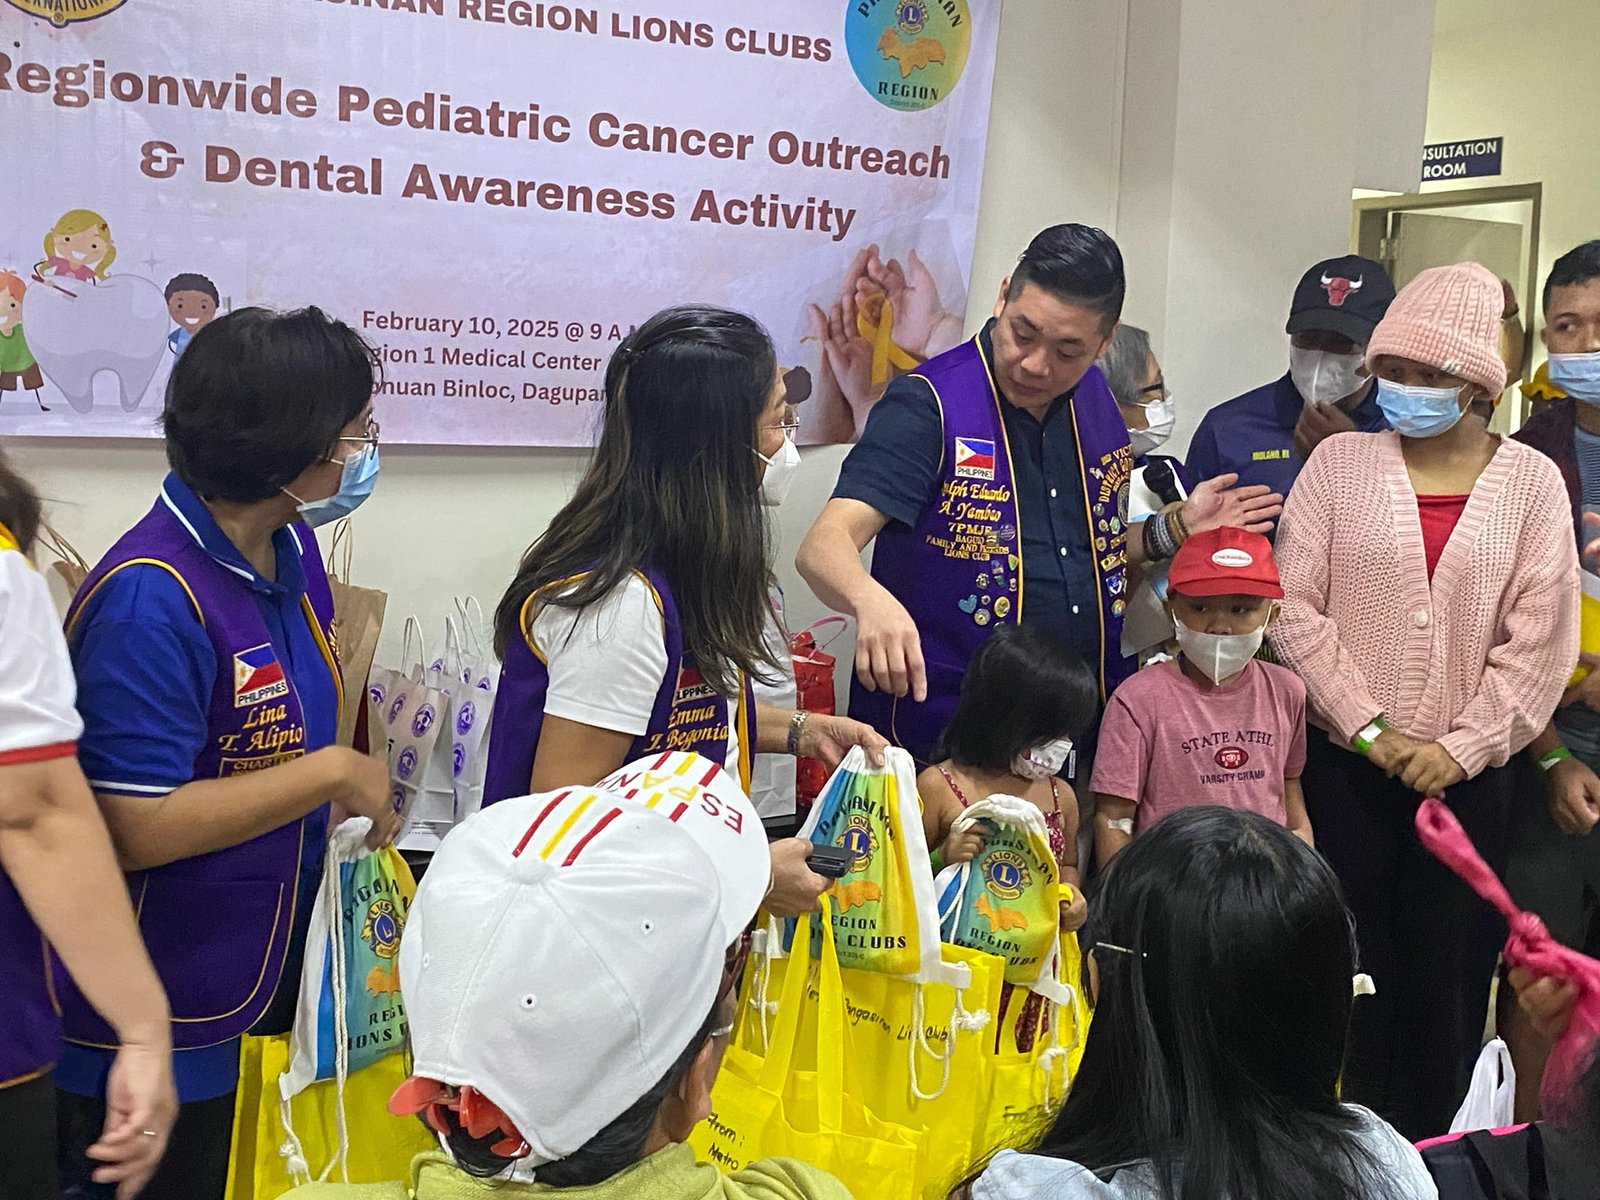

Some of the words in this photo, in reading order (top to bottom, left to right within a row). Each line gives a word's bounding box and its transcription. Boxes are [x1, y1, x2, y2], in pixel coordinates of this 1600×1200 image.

[458, 0, 598, 34] REGION
[611, 12, 714, 49] LIONS
[725, 27, 832, 62] CLUBS
[878, 81, 940, 101] REGION
[338, 85, 571, 144] Pediatric
[588, 112, 754, 161] Cancer
[768, 131, 951, 180] Outreach
[1424, 162, 1467, 179] ROOM
[139, 140, 184, 179] &
[205, 145, 382, 196] Dental
[402, 163, 676, 220] Awareness
[690, 189, 857, 242] Activity
[363, 310, 464, 338] February
[469, 316, 502, 340] 10,
[507, 319, 559, 338] 2025
[565, 322, 584, 342] @
[590, 323, 602, 340] 9
[423, 346, 435, 364] 1
[442, 347, 527, 368] Medical
[532, 351, 602, 371] Center
[443, 379, 516, 402] Binloc,
[957, 467, 993, 479] PHILIPPINES
[237, 681, 287, 704] PHILIPPINES
[242, 703, 288, 730] Lina
[668, 704, 716, 729] Emma
[245, 723, 303, 757] Alipio
[665, 722, 729, 751] Begonia
[1181, 731, 1231, 755] STATE
[847, 934, 907, 950] CLUBS
[970, 926, 1022, 953] REGION
